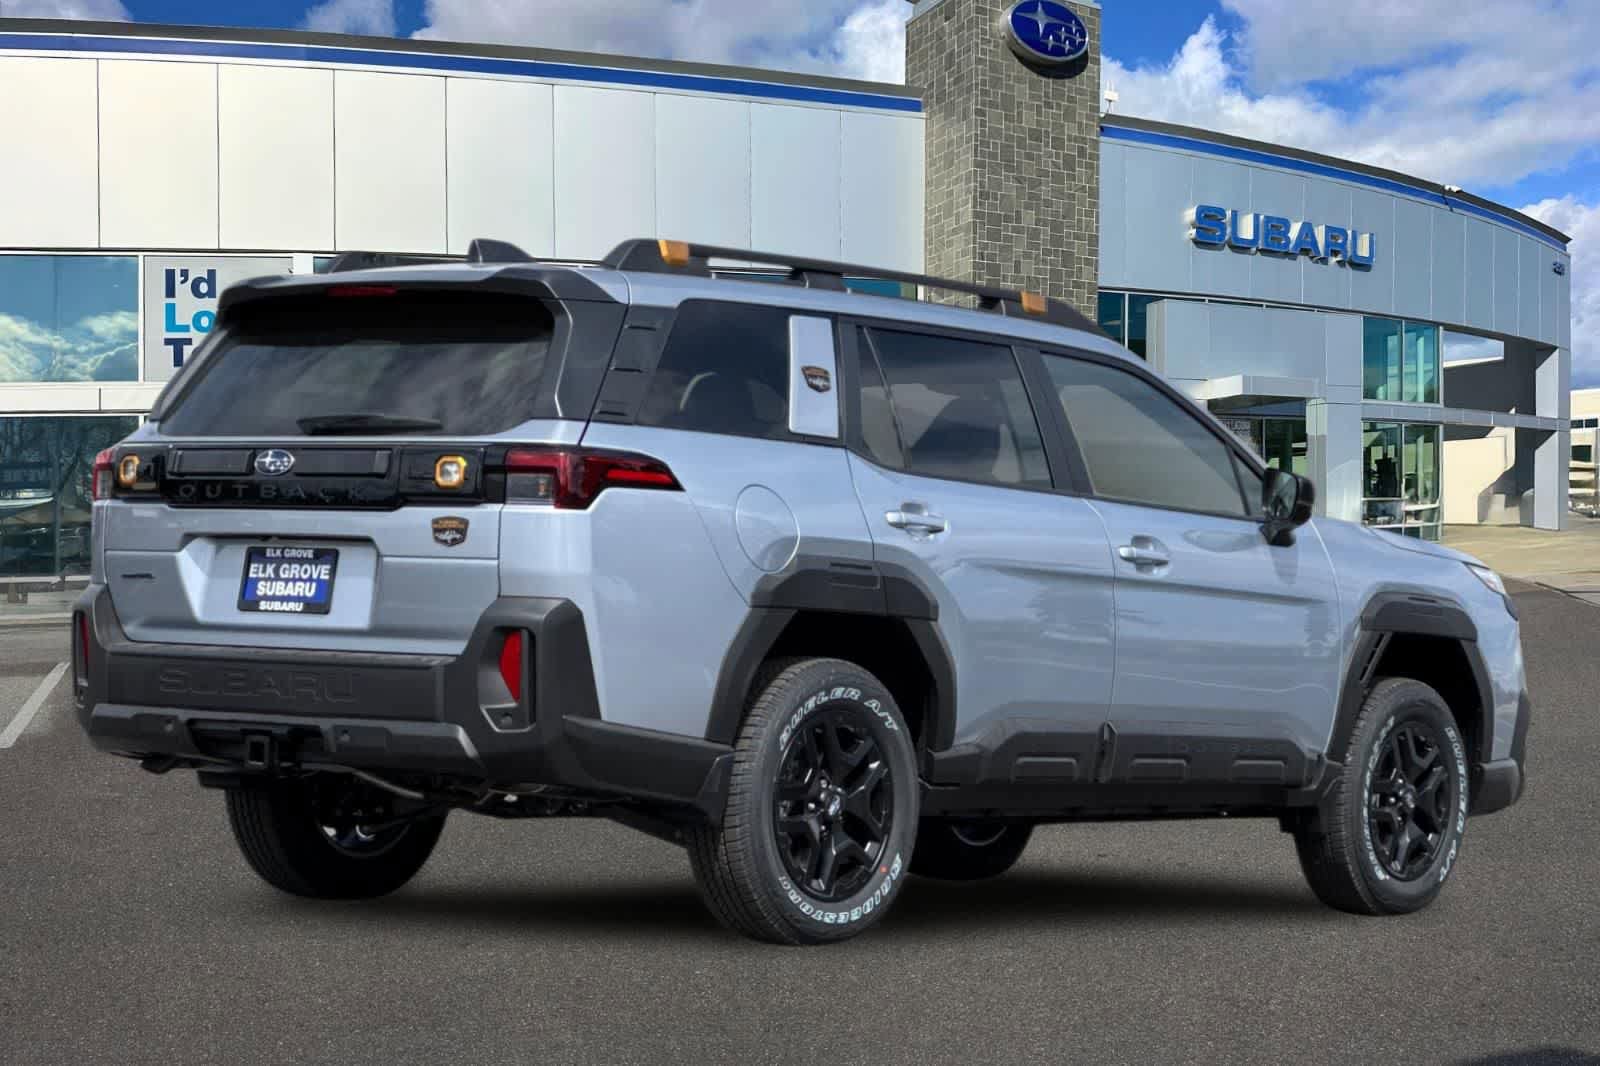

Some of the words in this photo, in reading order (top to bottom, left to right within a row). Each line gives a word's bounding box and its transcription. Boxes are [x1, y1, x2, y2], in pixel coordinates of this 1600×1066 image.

[1189, 204, 1376, 270] SUBARU
[165, 268, 217, 299] I'd
[164, 337, 200, 368] T
[178, 482, 370, 501] OUTBACK
[266, 548, 282, 558] ELK
[284, 548, 314, 559] GROVE
[249, 563, 276, 578] ELK
[279, 563, 331, 579] GROVE
[256, 581, 317, 597] SUBARU
[259, 600, 304, 611] SUBARU
[158, 667, 359, 704] SUBARU
